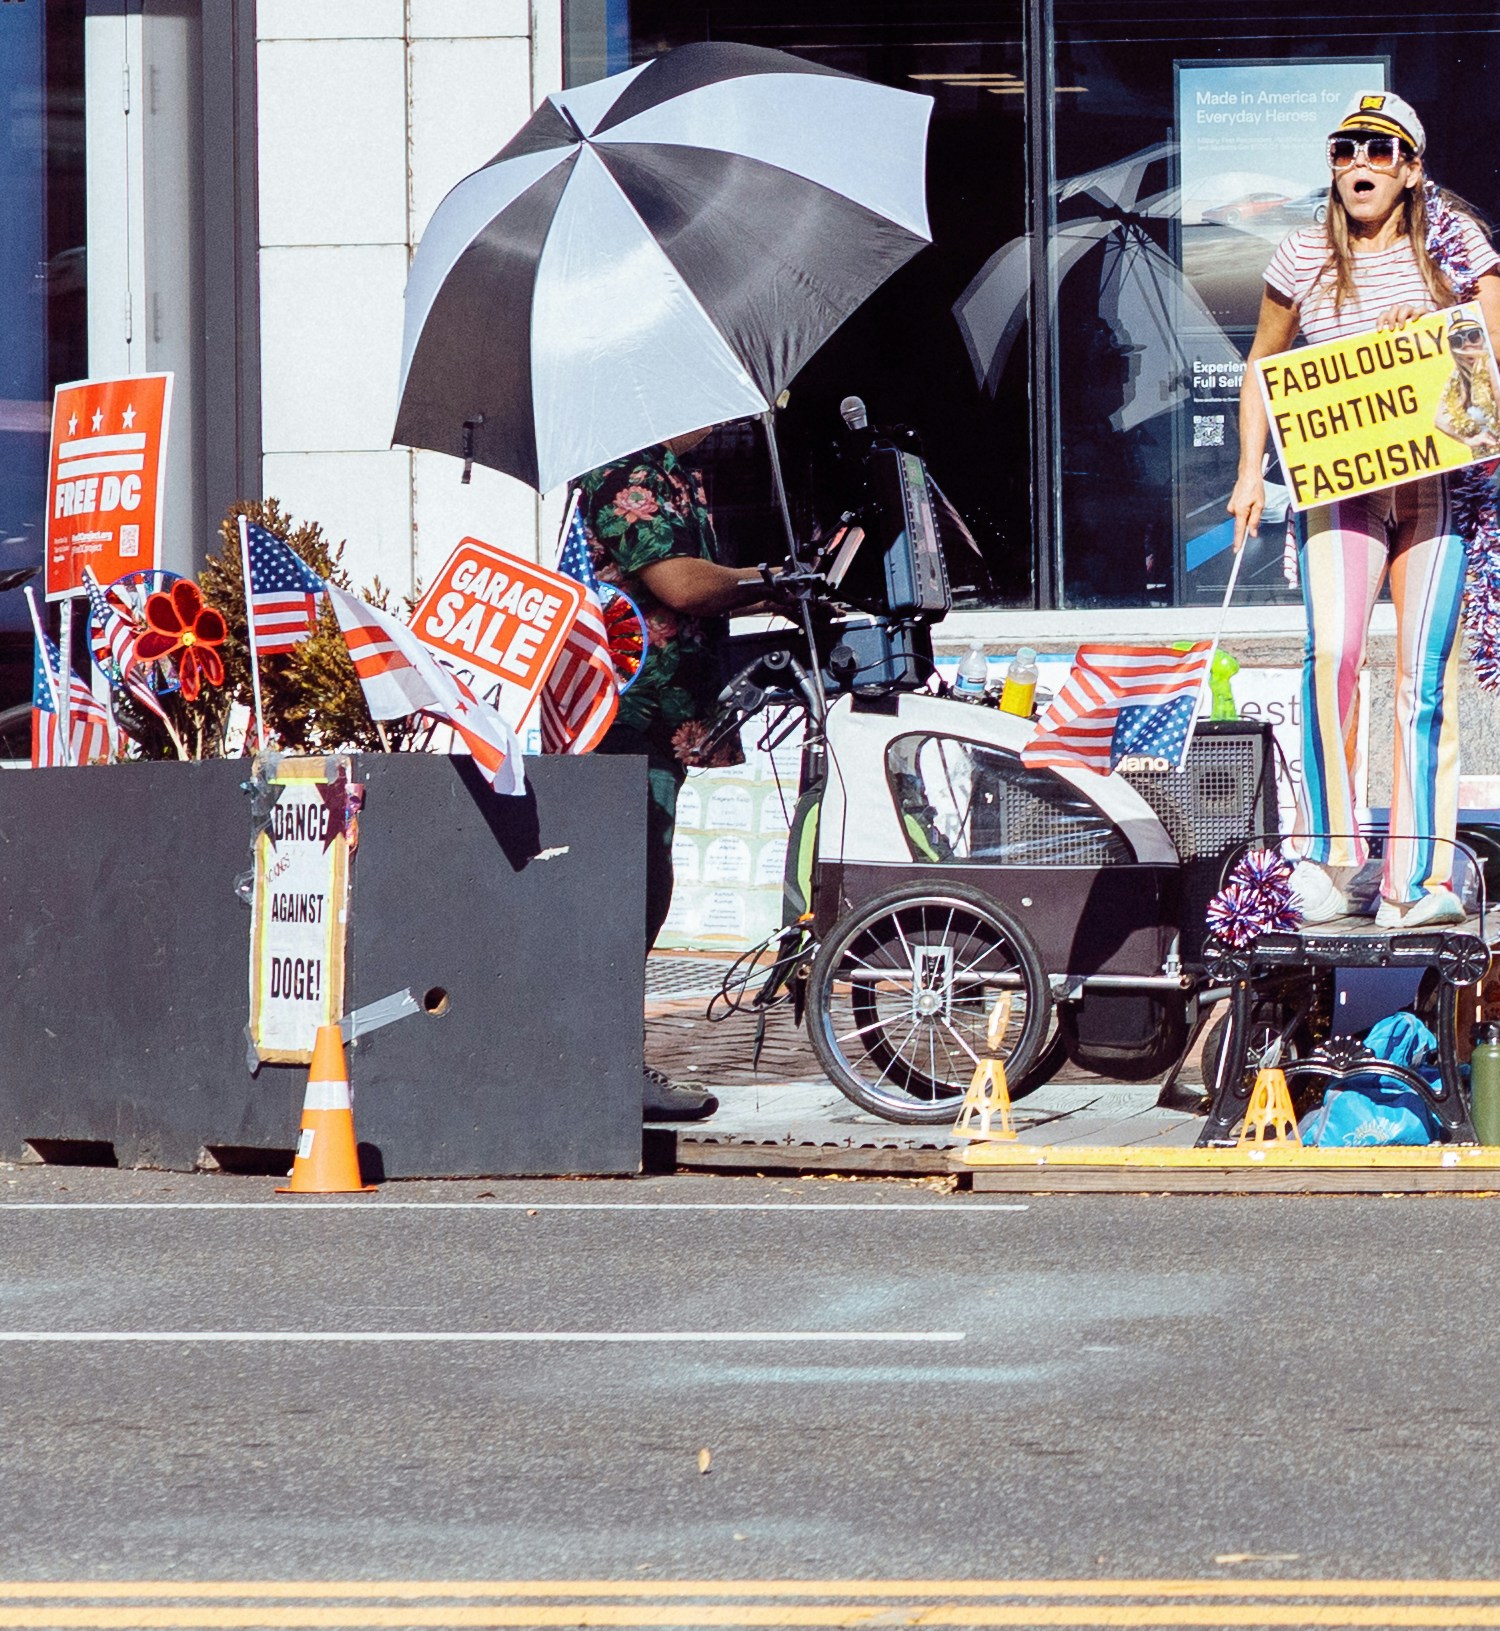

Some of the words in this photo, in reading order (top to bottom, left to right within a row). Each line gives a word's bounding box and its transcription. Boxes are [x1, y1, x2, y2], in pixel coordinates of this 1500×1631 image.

[1196, 91, 1238, 105] Made
[1241, 90, 1254, 105] in
[1257, 90, 1317, 105] America
[1321, 88, 1341, 104] for
[1196, 109, 1263, 126] Everyday
[1265, 109, 1317, 123] Heroes
[1193, 361, 1248, 375] Experien
[1193, 376, 1216, 388] Full
[1218, 375, 1244, 388] Self
[1261, 325, 1445, 400] FABULOUSLY
[1274, 384, 1418, 448] FIGHTING
[1288, 434, 1441, 503] FASCISM
[54, 477, 100, 520] FREE
[99, 474, 142, 512] DC
[451, 559, 563, 631] GARAGE
[425, 591, 546, 678] SALE
[273, 803, 329, 842] DANCE
[271, 893, 324, 923] AGAINST
[270, 957, 321, 1001] DOGE!
